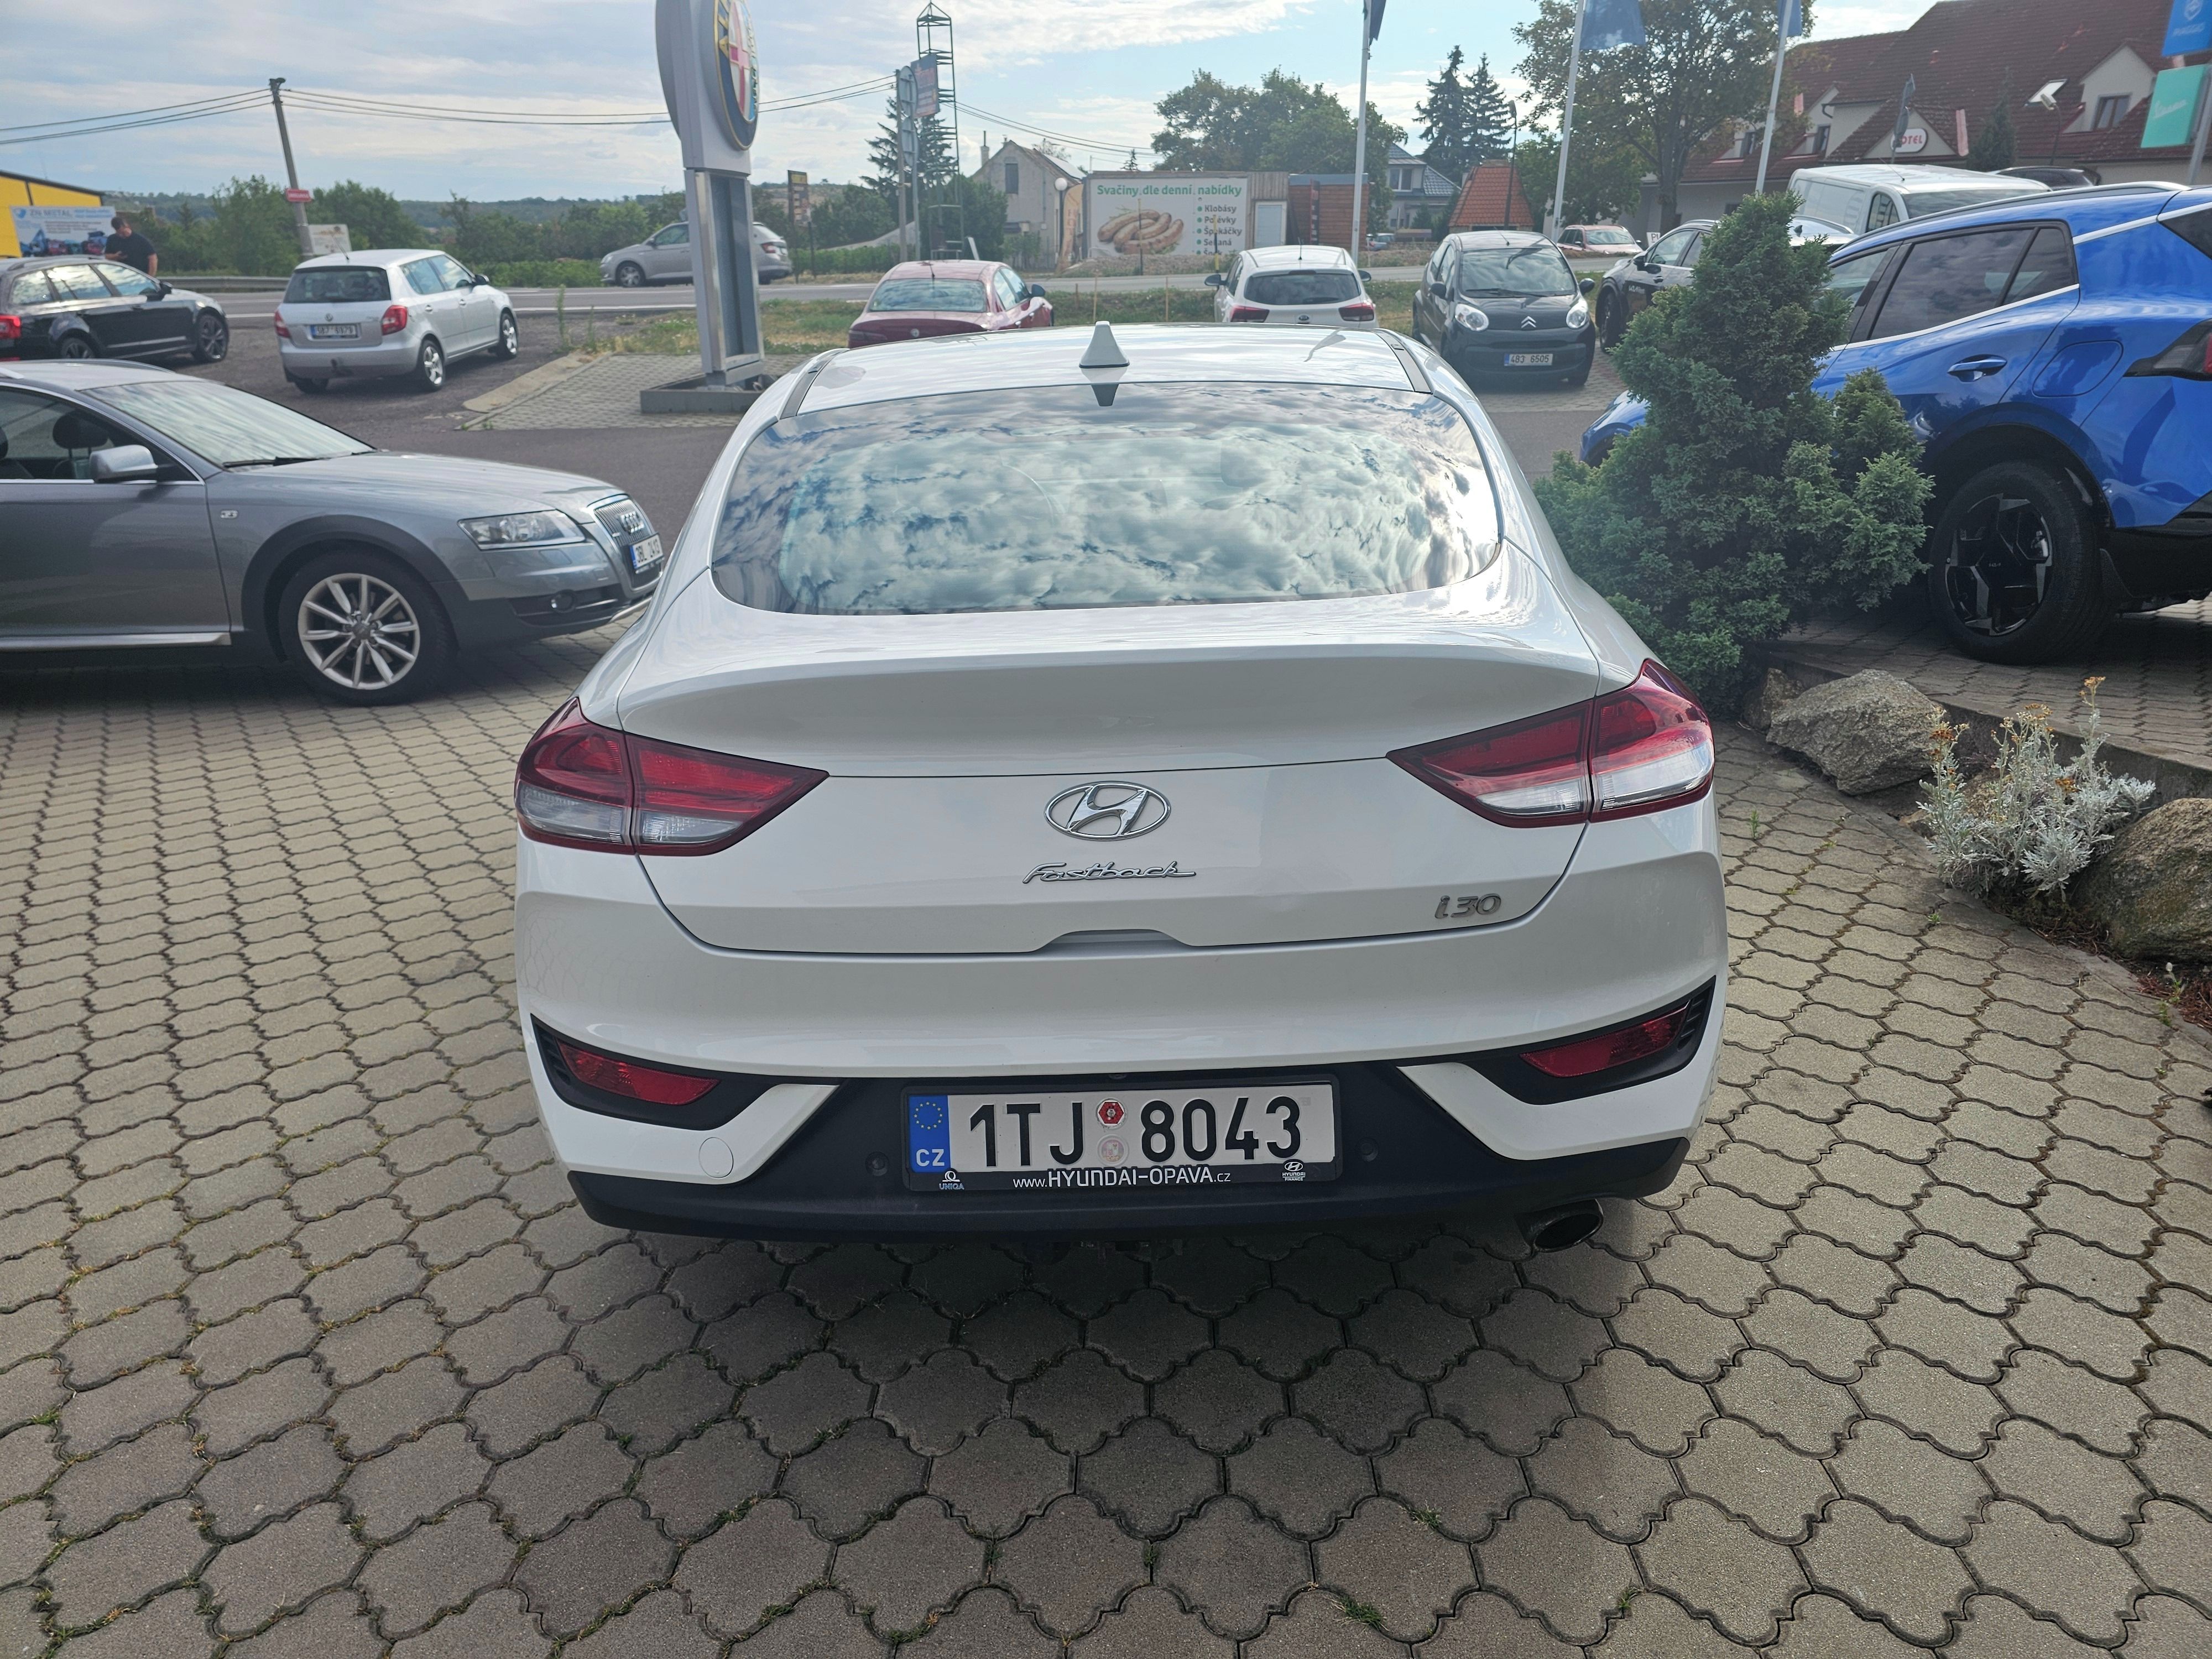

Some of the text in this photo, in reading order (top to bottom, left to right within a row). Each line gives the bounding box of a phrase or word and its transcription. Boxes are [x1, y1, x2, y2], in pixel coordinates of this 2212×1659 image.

[1898, 134, 1923, 145] OTEL
[1097, 184, 1242, 197] Svačiny dle denní nabídky
[1204, 204, 1237, 214] Klobásy
[1204, 216, 1237, 225] Poévky
[1204, 226, 1243, 236] Špkáčky
[1530, 355, 1550, 363] 6505
[1022, 860, 1197, 884] Fastback
[1434, 893, 1501, 919] i30
[969, 1095, 1301, 1167] 1TJ 8043
[916, 1149, 945, 1167] CZ
